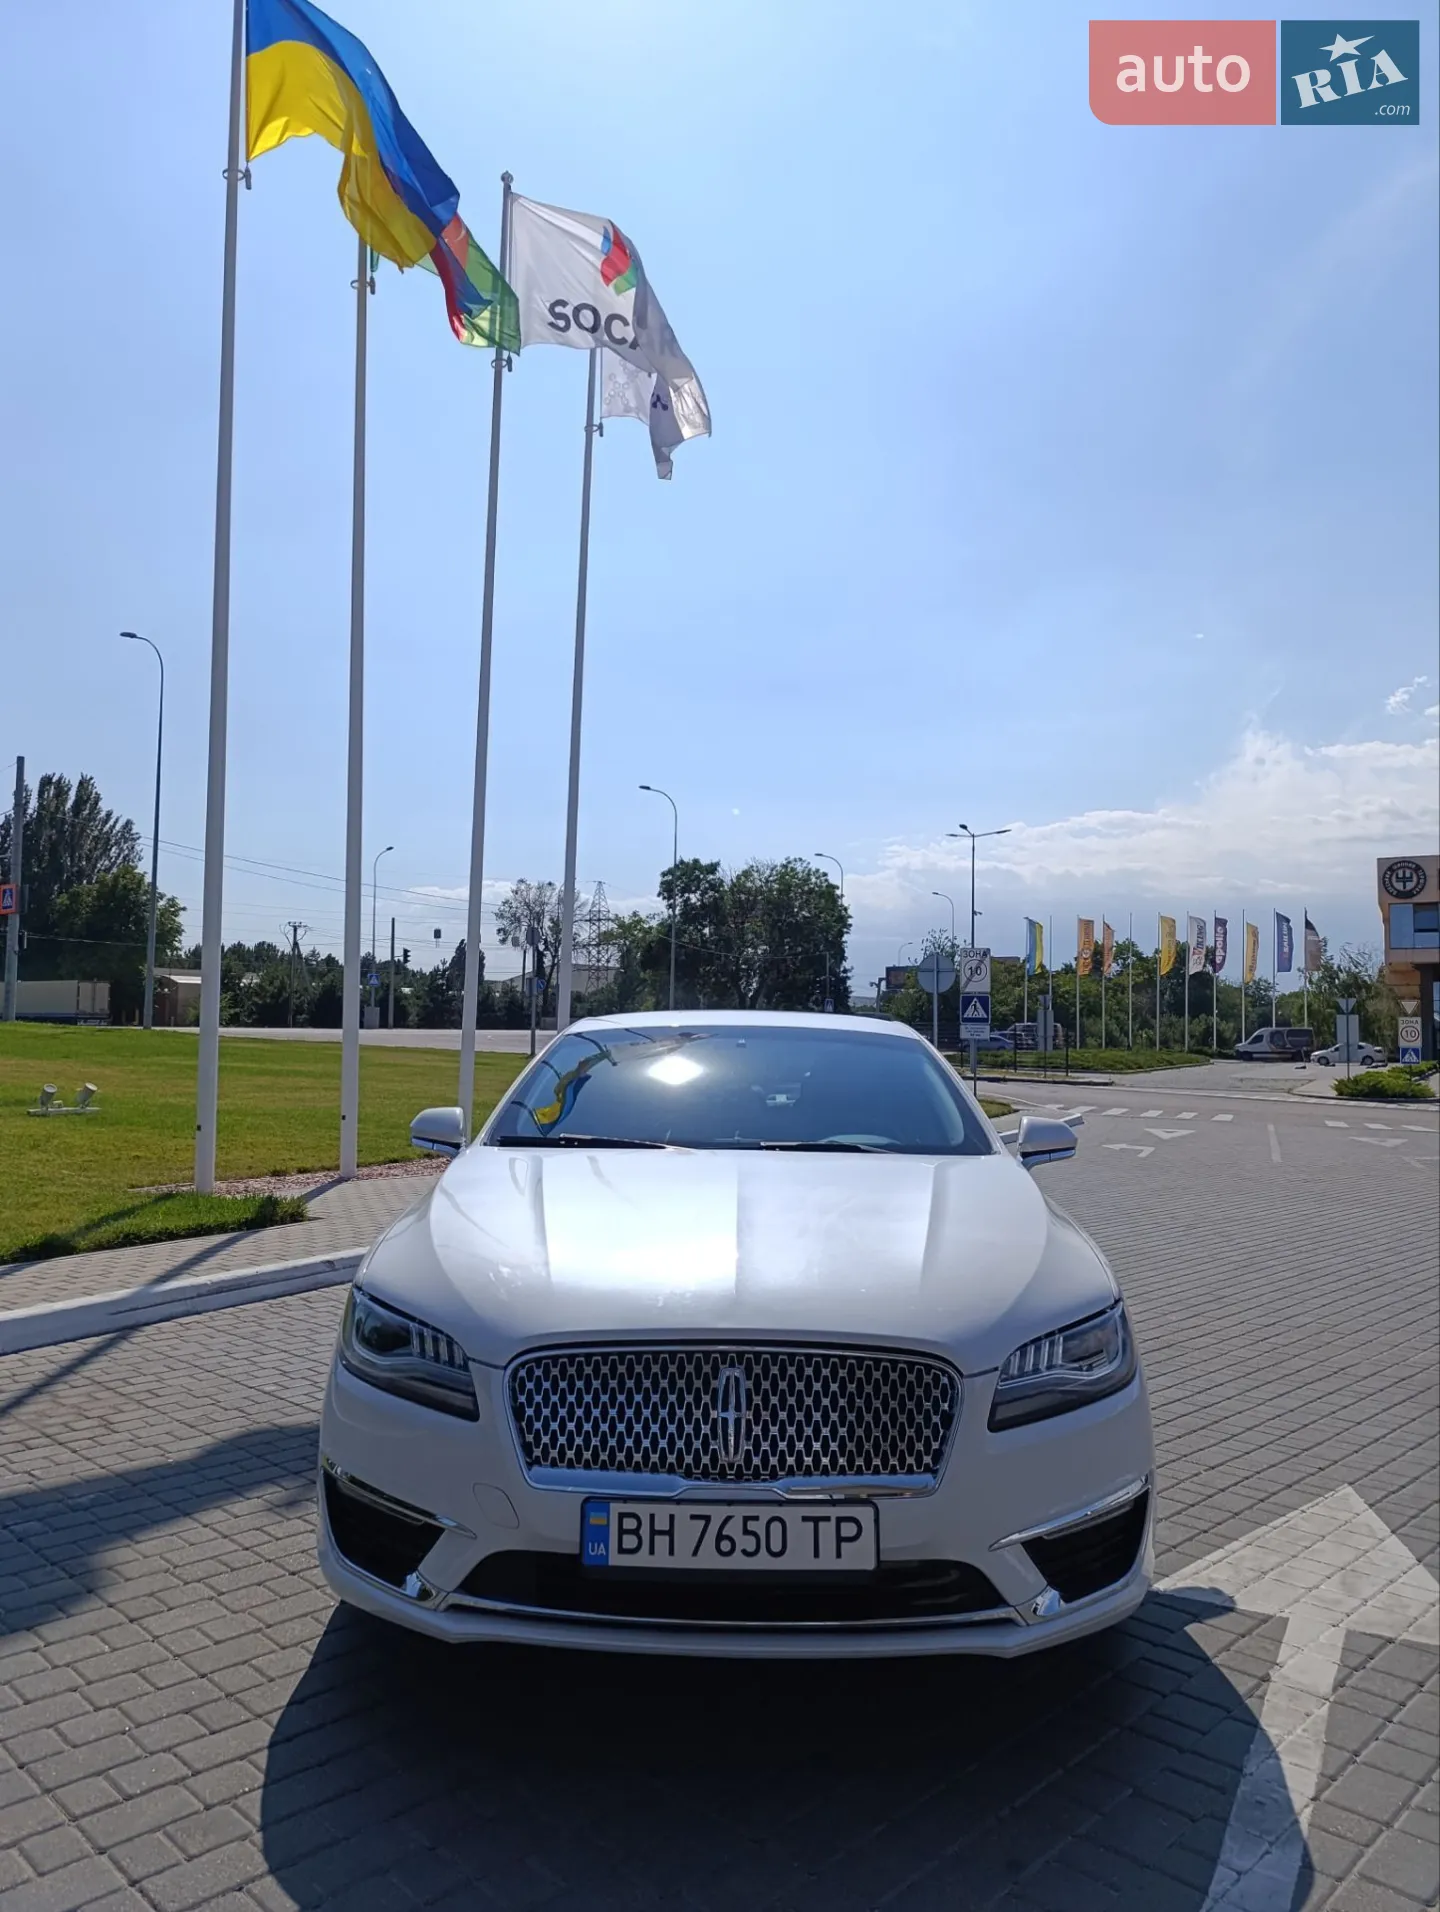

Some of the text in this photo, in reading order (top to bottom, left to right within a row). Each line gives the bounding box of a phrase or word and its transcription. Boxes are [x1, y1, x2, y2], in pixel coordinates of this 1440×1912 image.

[1215, 926, 1225, 964] apollo
[962, 950, 988, 959] ЗОНА
[968, 966, 982, 976] 10
[1404, 1029, 1417, 1039] 10
[617, 1511, 863, 1560] BH 7650 TP
[588, 1542, 606, 1556] UA
